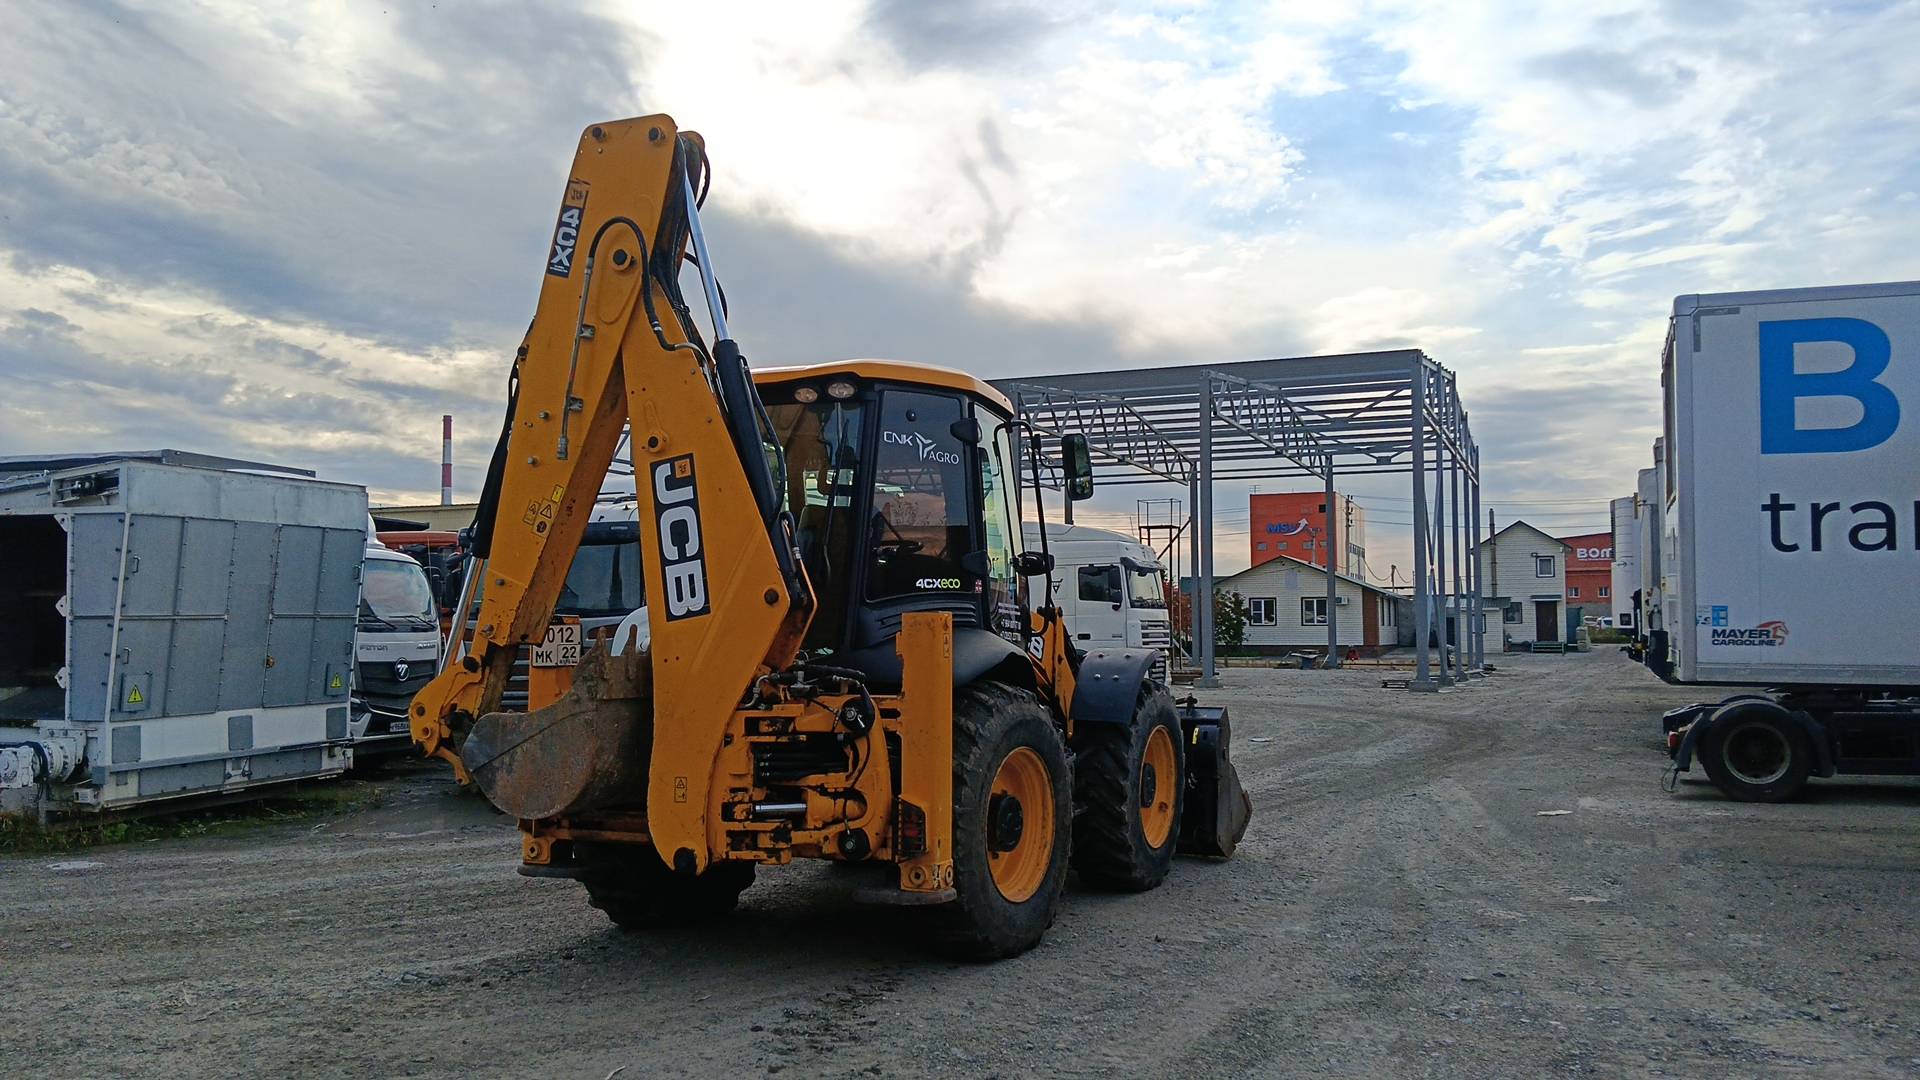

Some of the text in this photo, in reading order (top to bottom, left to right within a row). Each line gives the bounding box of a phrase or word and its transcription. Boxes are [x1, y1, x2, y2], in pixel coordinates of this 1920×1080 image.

[551, 208, 580, 267] 4CX
[1758, 316, 1901, 455] B
[928, 451, 960, 465] AGRO
[655, 463, 706, 617] JCB
[915, 578, 961, 589] 4CXeco
[1711, 628, 1771, 639] MAYER
[1711, 639, 1777, 647] CARGOLINE
[562, 646, 577, 659] 22
